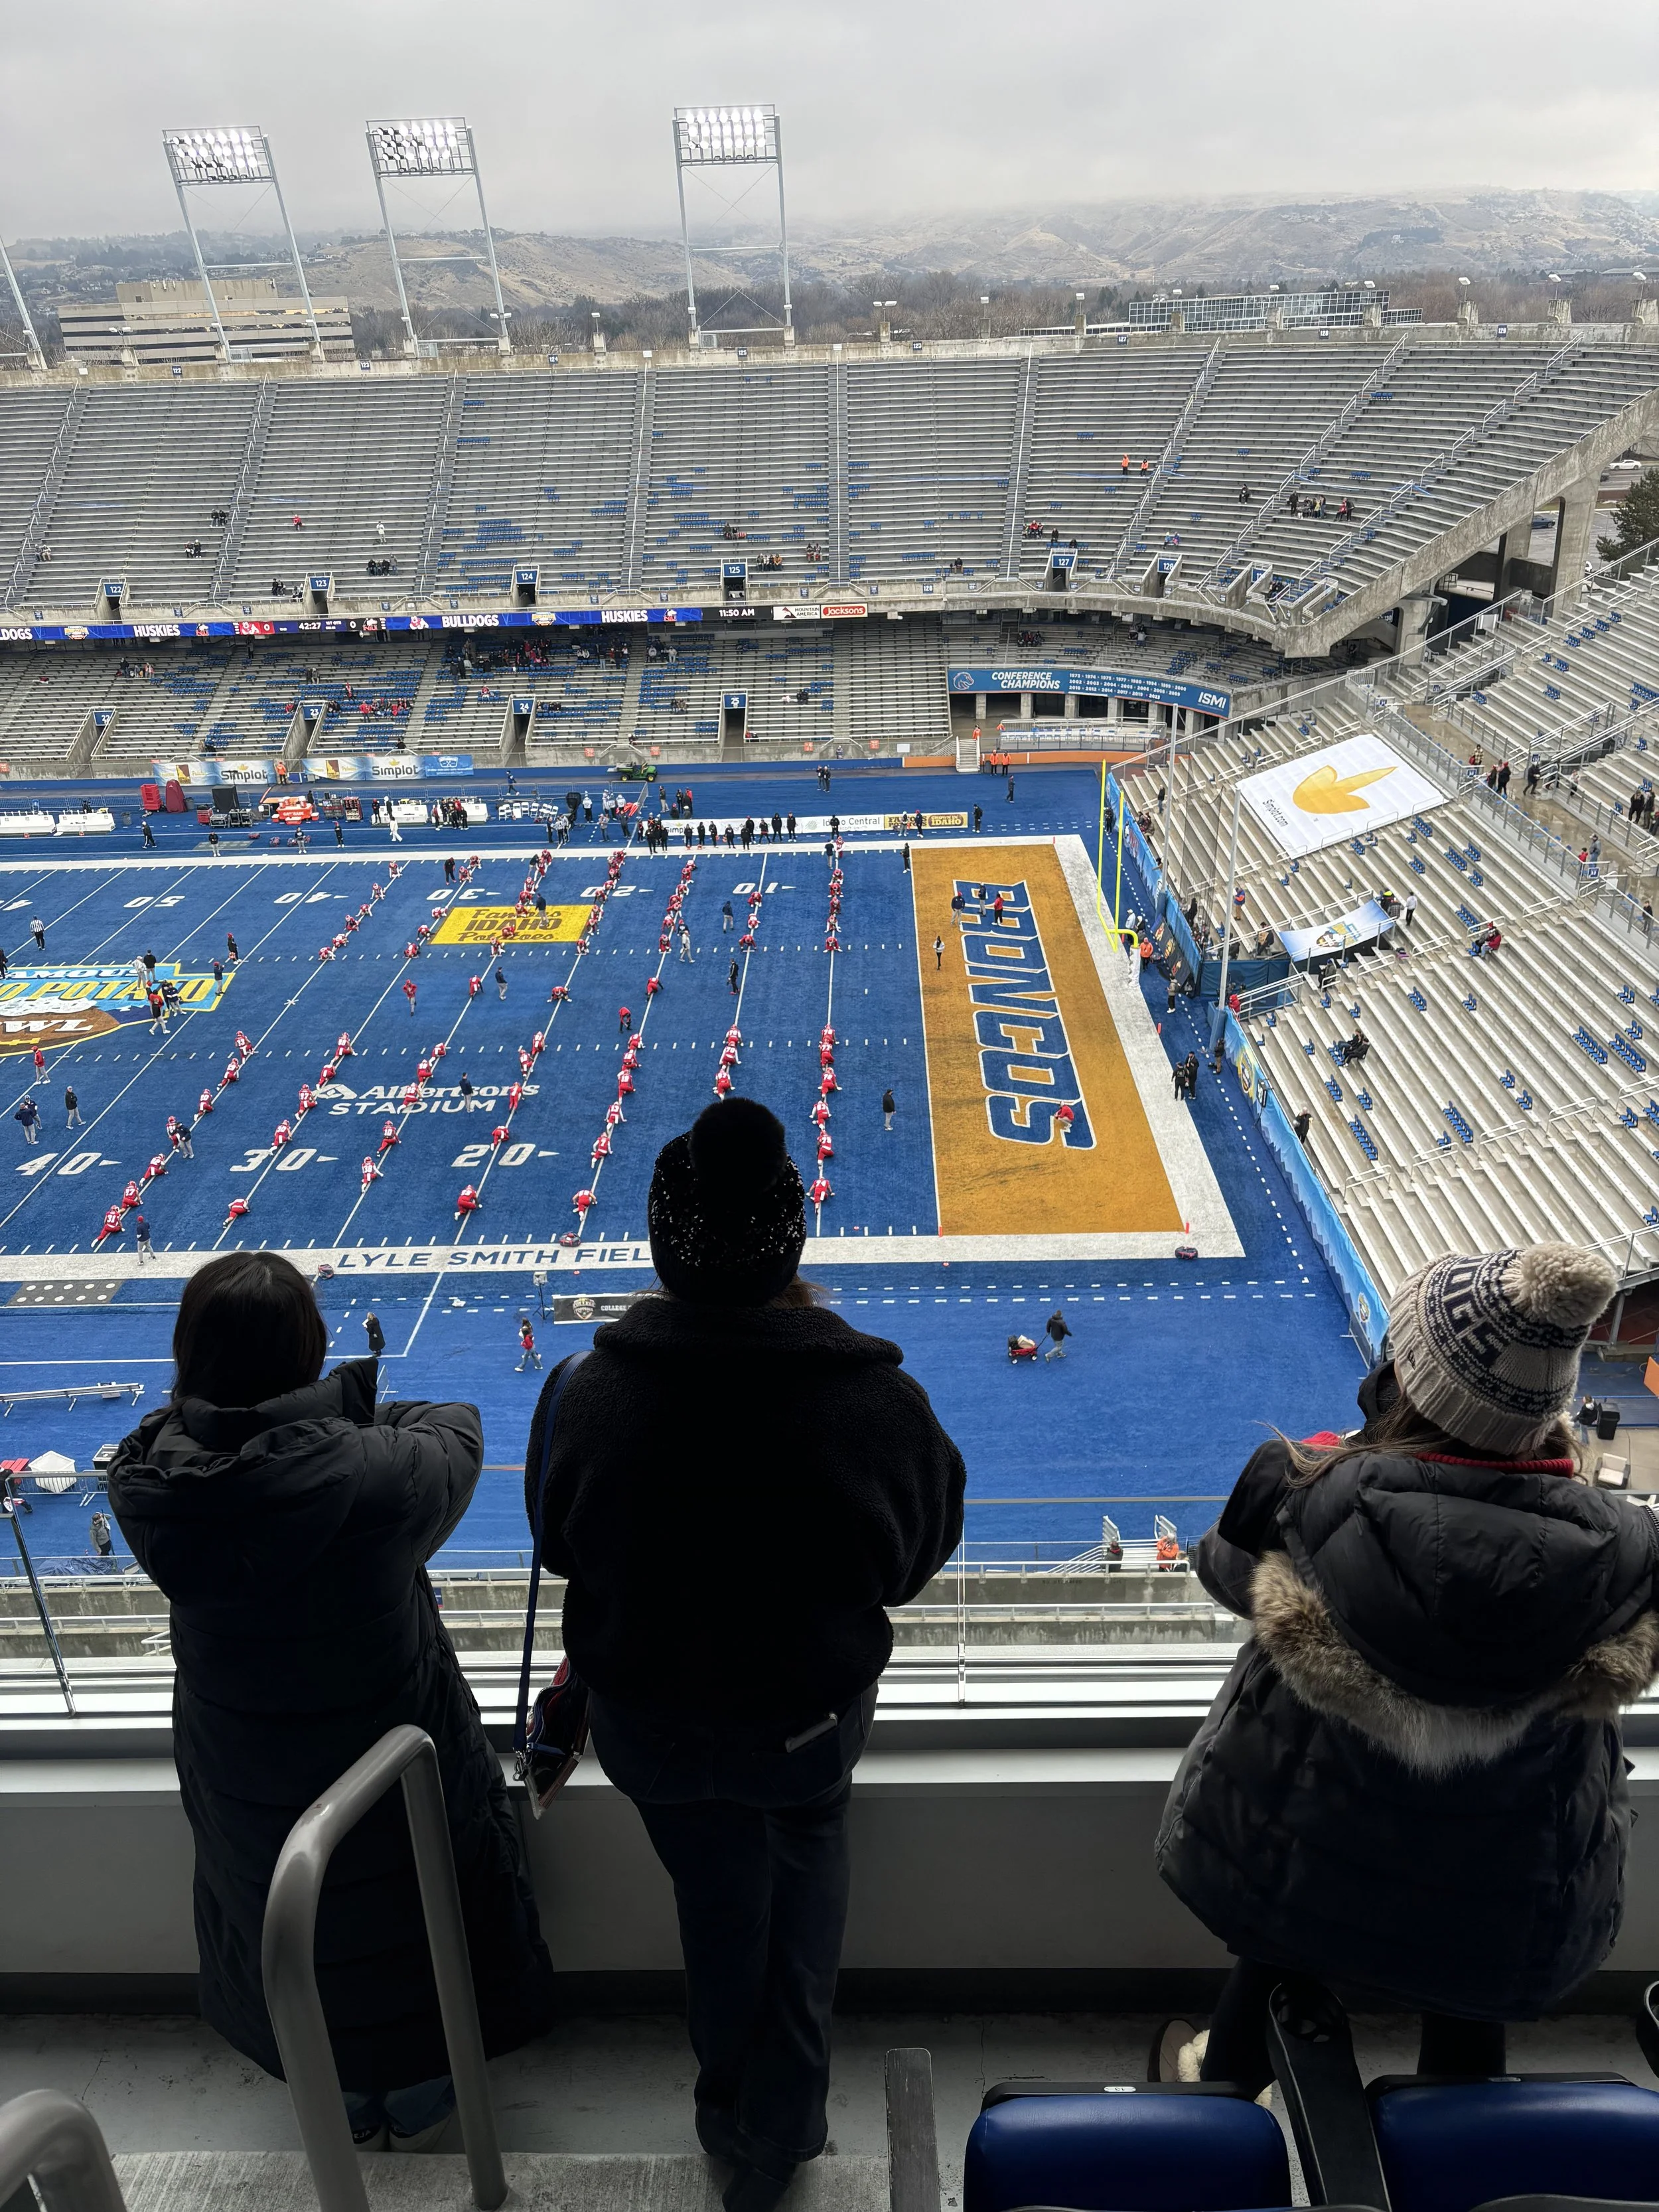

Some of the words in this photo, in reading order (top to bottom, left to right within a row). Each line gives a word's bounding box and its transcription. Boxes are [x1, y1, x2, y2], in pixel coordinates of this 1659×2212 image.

[1163, 562, 1174, 571] 128
[601, 609, 648, 623] HUSKIES
[719, 609, 740, 618] 11:50
[826, 607, 863, 616] Jacksons
[299, 622, 321, 630] 42:27
[442, 614, 499, 628] BULLDOGS
[133, 624, 180, 638] HUSKIES
[991, 672, 1052, 680] CONFERENCE
[1001, 680, 1061, 690] CHAMPIONS
[1198, 692, 1226, 709] ISMI
[221, 769, 267, 782] Simplot
[372, 765, 419, 778] Simplot
[823, 818, 846, 827] Ido
[849, 816, 881, 826] Central
[465, 918, 563, 931] IDAHO
[458, 932, 554, 942] Pottoes
[952, 879, 1097, 1149] BRONCOS
[328, 1099, 496, 1116] STADIUM
[230, 1149, 317, 1172] 30
[451, 1143, 536, 1167] 20
[15, 1153, 102, 1176] 40
[337, 1252, 433, 1268] LYLE
[447, 1249, 561, 1266] SMITH
[574, 1247, 652, 1262] FIEL
